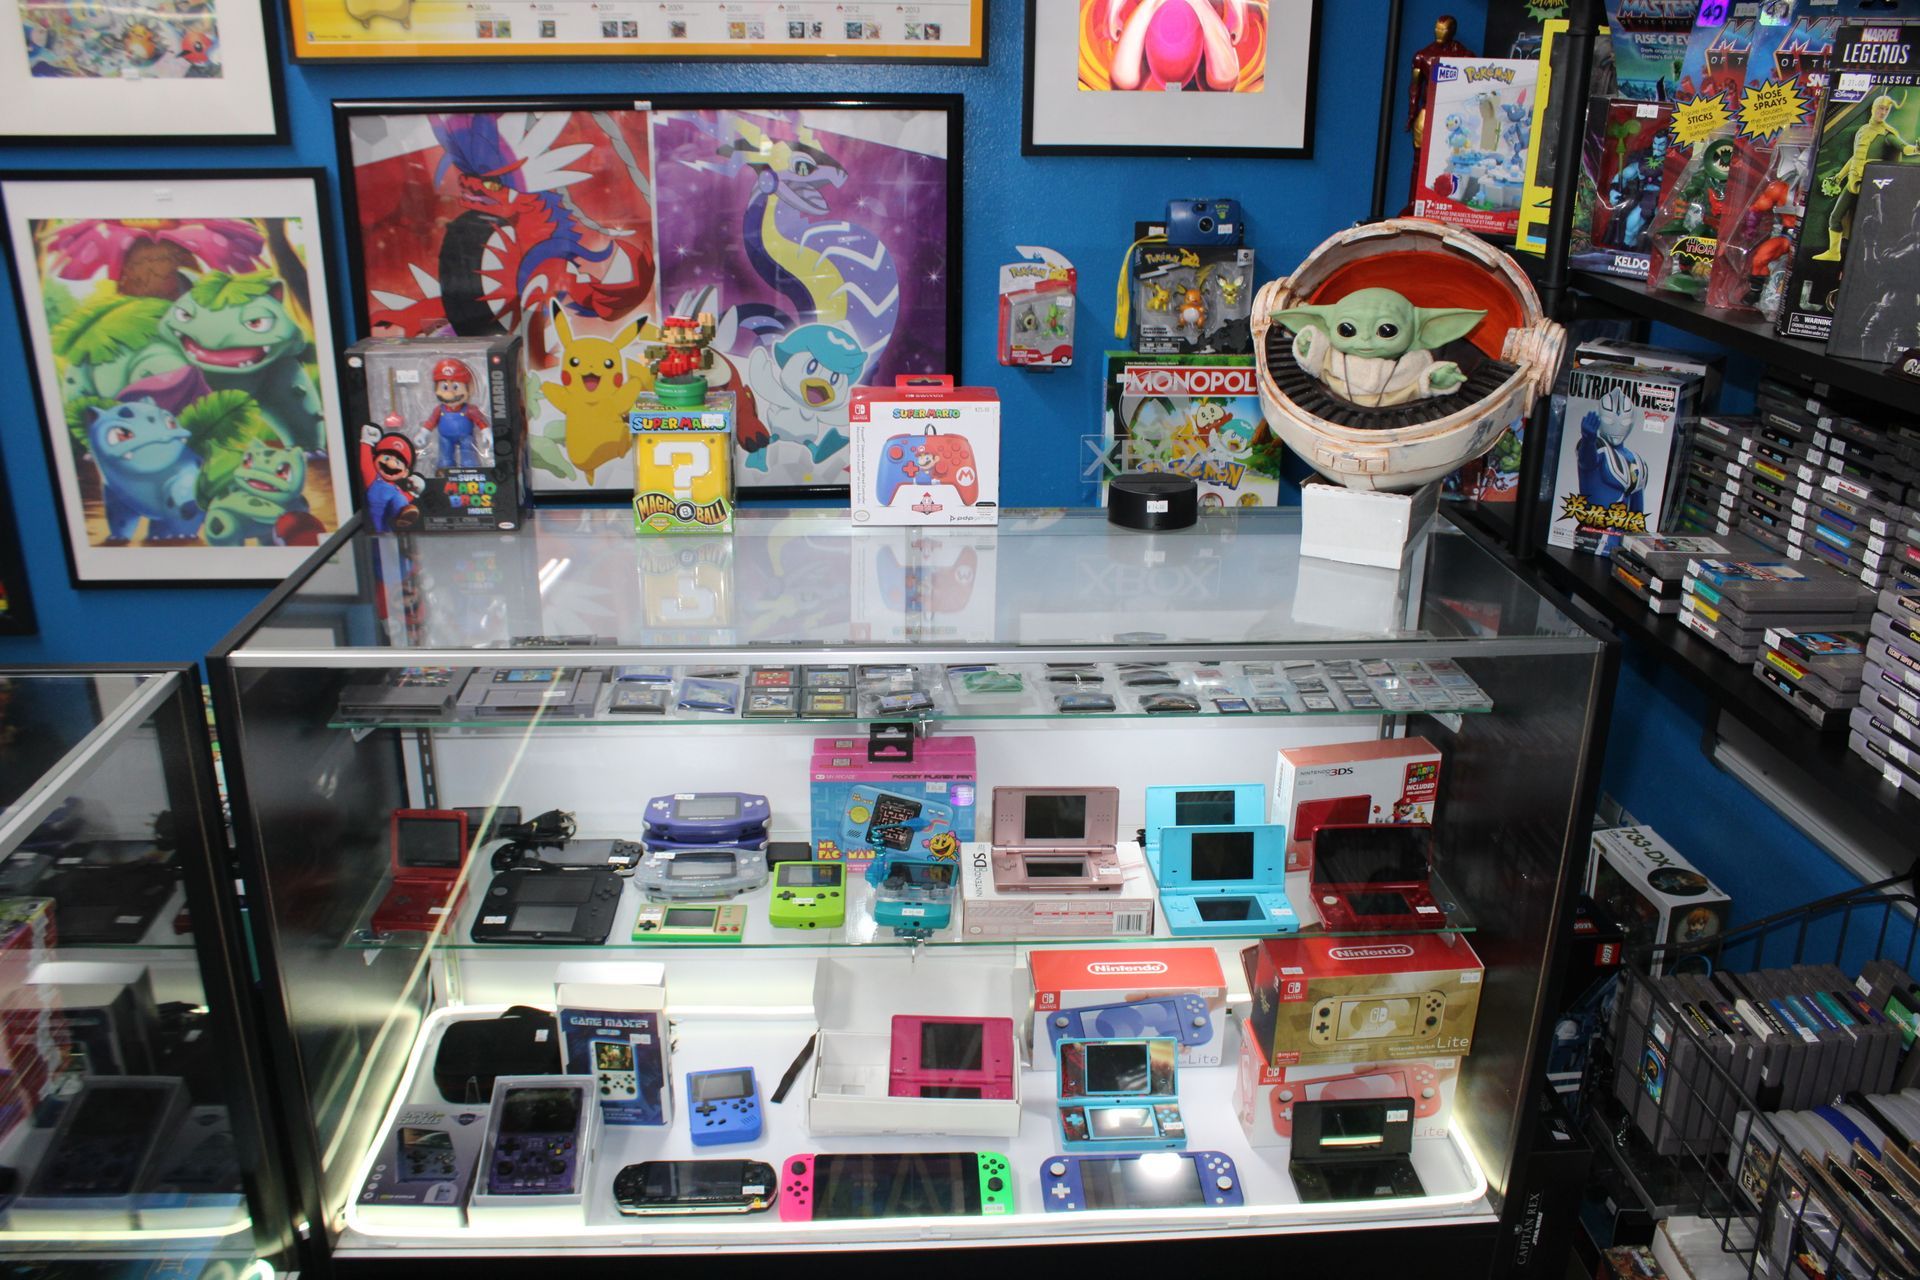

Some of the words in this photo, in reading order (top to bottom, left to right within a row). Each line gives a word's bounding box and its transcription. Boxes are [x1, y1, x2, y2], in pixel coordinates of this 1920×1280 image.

[1635, 34, 1656, 45] RISE
[1658, 34, 1674, 45] OF
[1861, 28, 1900, 42] MARVEL
[1843, 43, 1911, 64] LEGENDS
[1439, 69, 1458, 79] MEGA
[1871, 75, 1912, 85] CLASSIC
[1757, 89, 1783, 101] NOSE
[1753, 97, 1788, 111] SPRAYS
[1687, 112, 1713, 125] STICKS
[1129, 370, 1258, 392] MONOPOL
[491, 370, 506, 419] MARIO
[893, 408, 927, 419] SUPER
[926, 408, 961, 419] MARIO
[632, 417, 679, 431] SUPER
[444, 481, 497, 495] MARIO
[637, 494, 675, 521] MAGIC
[696, 500, 727, 524] BALL
[1898, 708, 1911, 720] FAMILY
[1329, 767, 1354, 776] 3DS
[1406, 782, 1436, 791] INCLUDED
[1620, 828, 1676, 867] 733-DX
[974, 853, 987, 869] DS
[1337, 946, 1408, 958] Nintendo
[1601, 944, 1612, 964] LEGO
[1094, 963, 1162, 973] Nintendo
[570, 1016, 602, 1028] GAME
[604, 1018, 649, 1029] MASTER
[1437, 1036, 1469, 1049] Lite
[1188, 1054, 1219, 1066] Lite
[1413, 1123, 1446, 1137] Lite
[1526, 1192, 1540, 1215] REX
[1535, 1210, 1543, 1229] WARS
[1532, 1228, 1540, 1246] STAR
